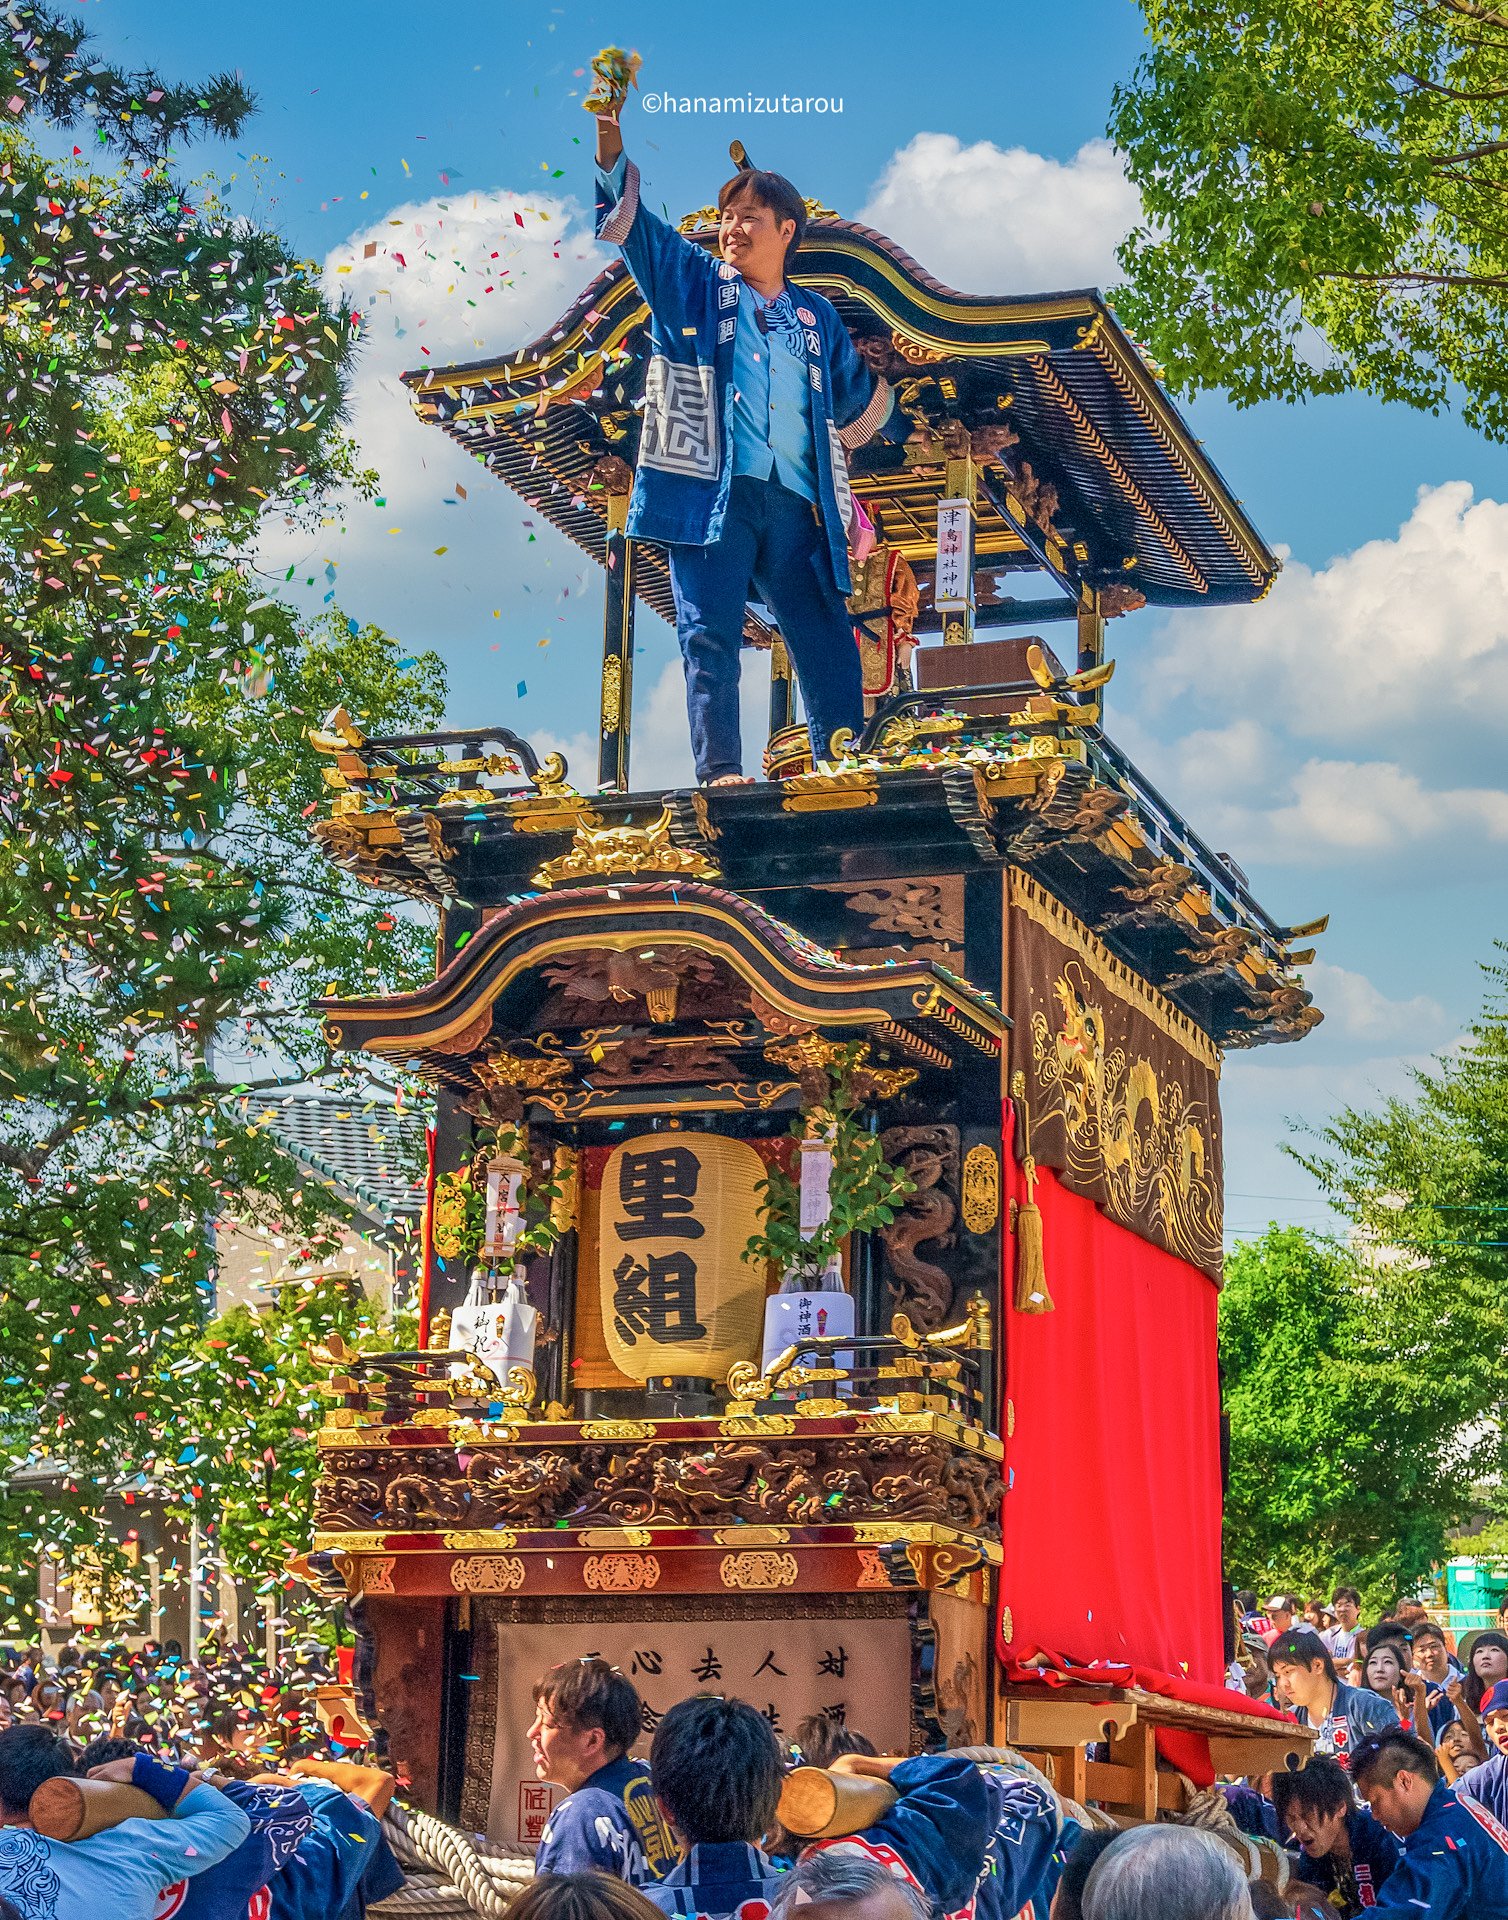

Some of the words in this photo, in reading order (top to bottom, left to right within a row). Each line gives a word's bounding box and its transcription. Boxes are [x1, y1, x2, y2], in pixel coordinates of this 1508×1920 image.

[613, 1147, 707, 1346] 里組
[798, 1298, 812, 1336] 御神酒
